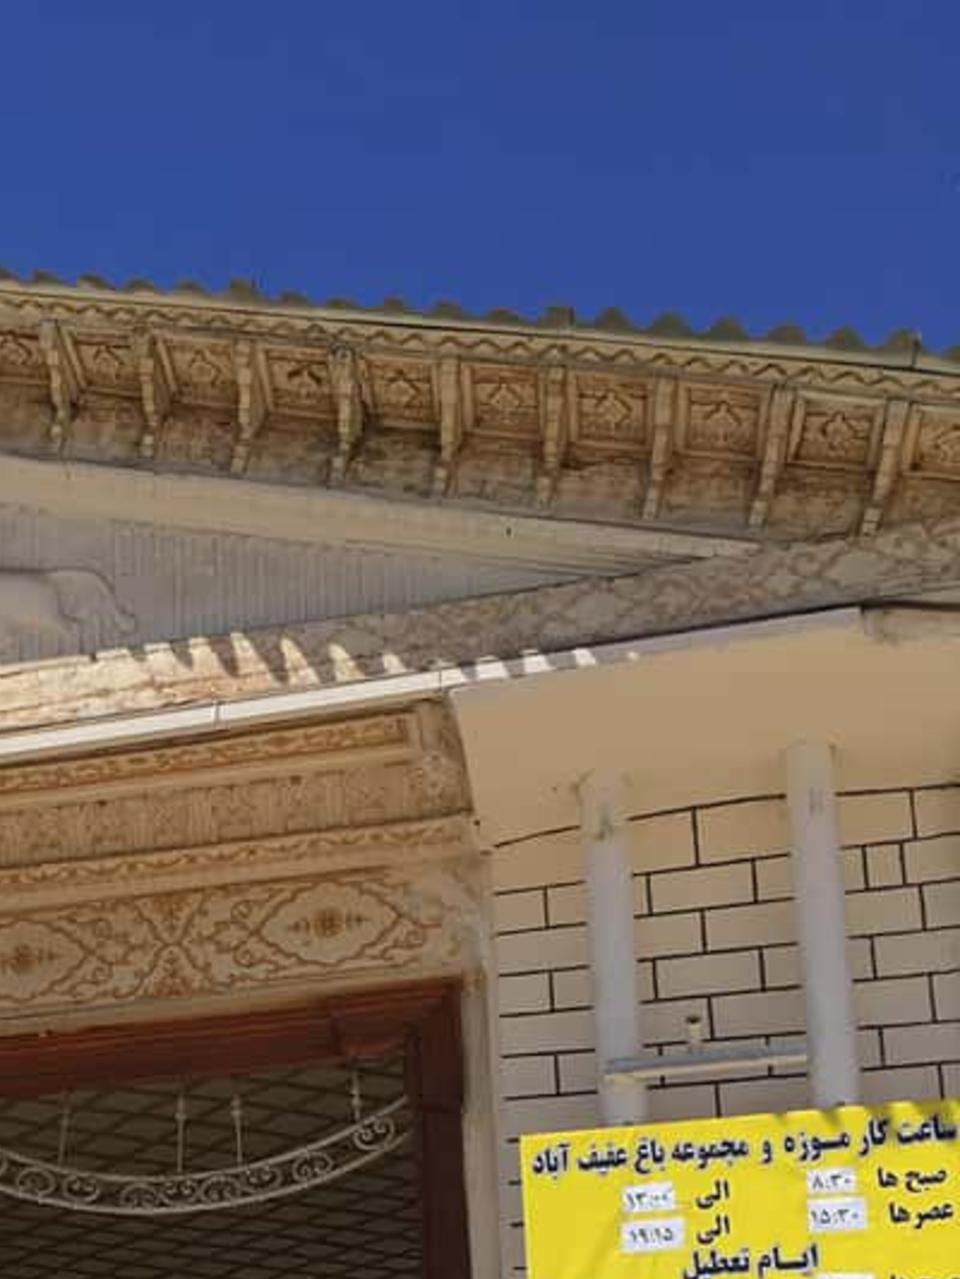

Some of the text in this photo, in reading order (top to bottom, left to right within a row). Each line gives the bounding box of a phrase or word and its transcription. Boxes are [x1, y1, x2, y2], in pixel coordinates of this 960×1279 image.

[532, 1114, 958, 1180] ساعت کار موزه و مجموعه باغ عفیف آباد
[695, 1179, 730, 1209] الی
[905, 1169, 948, 1193] صبح
[696, 1214, 731, 1244] الی
